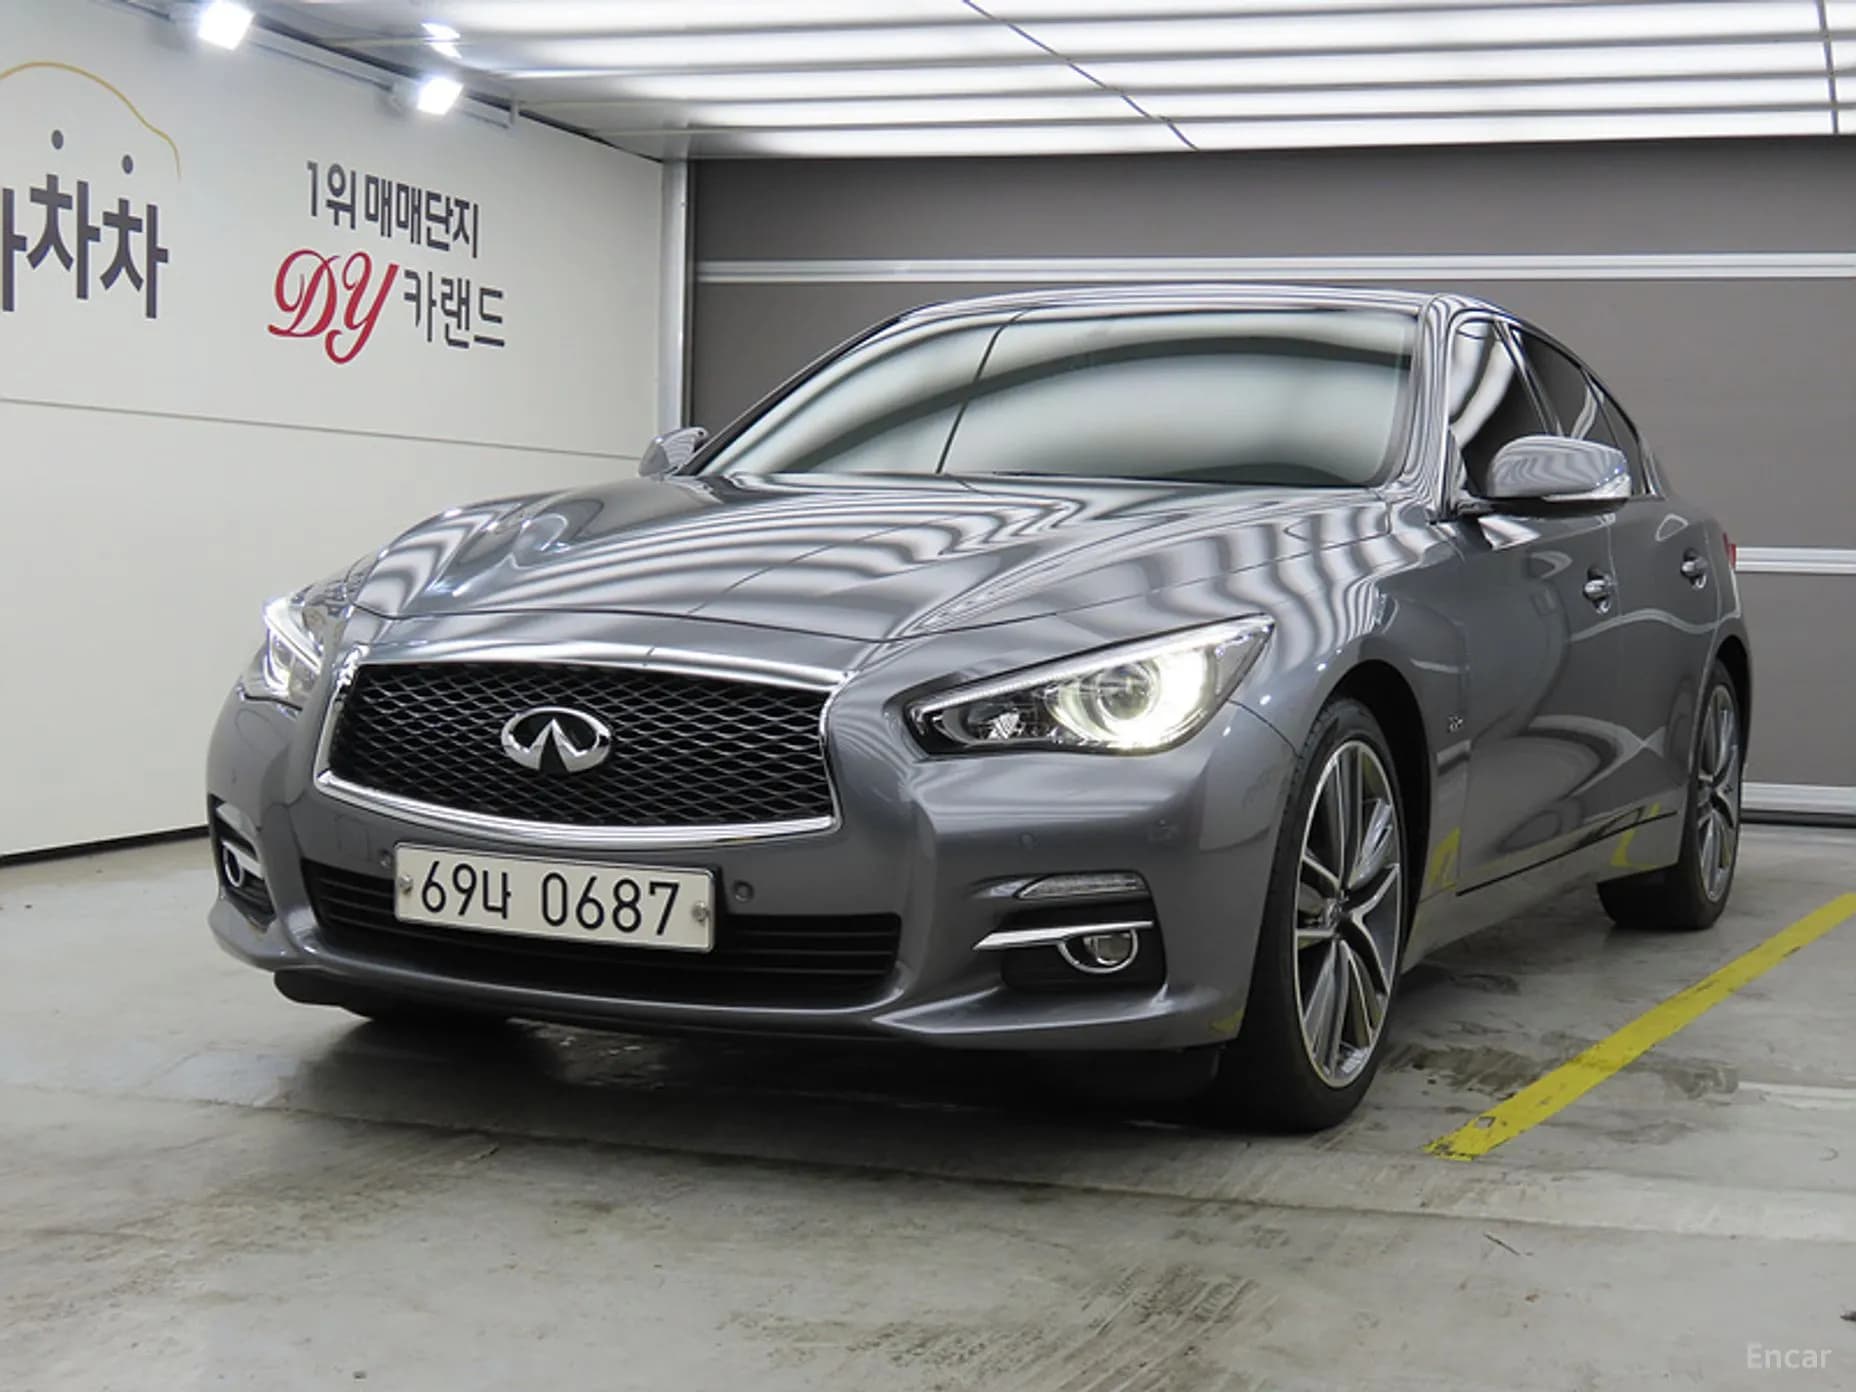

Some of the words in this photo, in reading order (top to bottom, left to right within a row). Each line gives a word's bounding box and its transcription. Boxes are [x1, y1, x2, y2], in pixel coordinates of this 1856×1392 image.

[307, 160, 356, 230] 1위
[365, 174, 479, 259] 매매단지
[267, 248, 400, 365] DY
[403, 269, 505, 349] 카랜드
[421, 860, 512, 919] 69나
[541, 872, 680, 936] 0687
